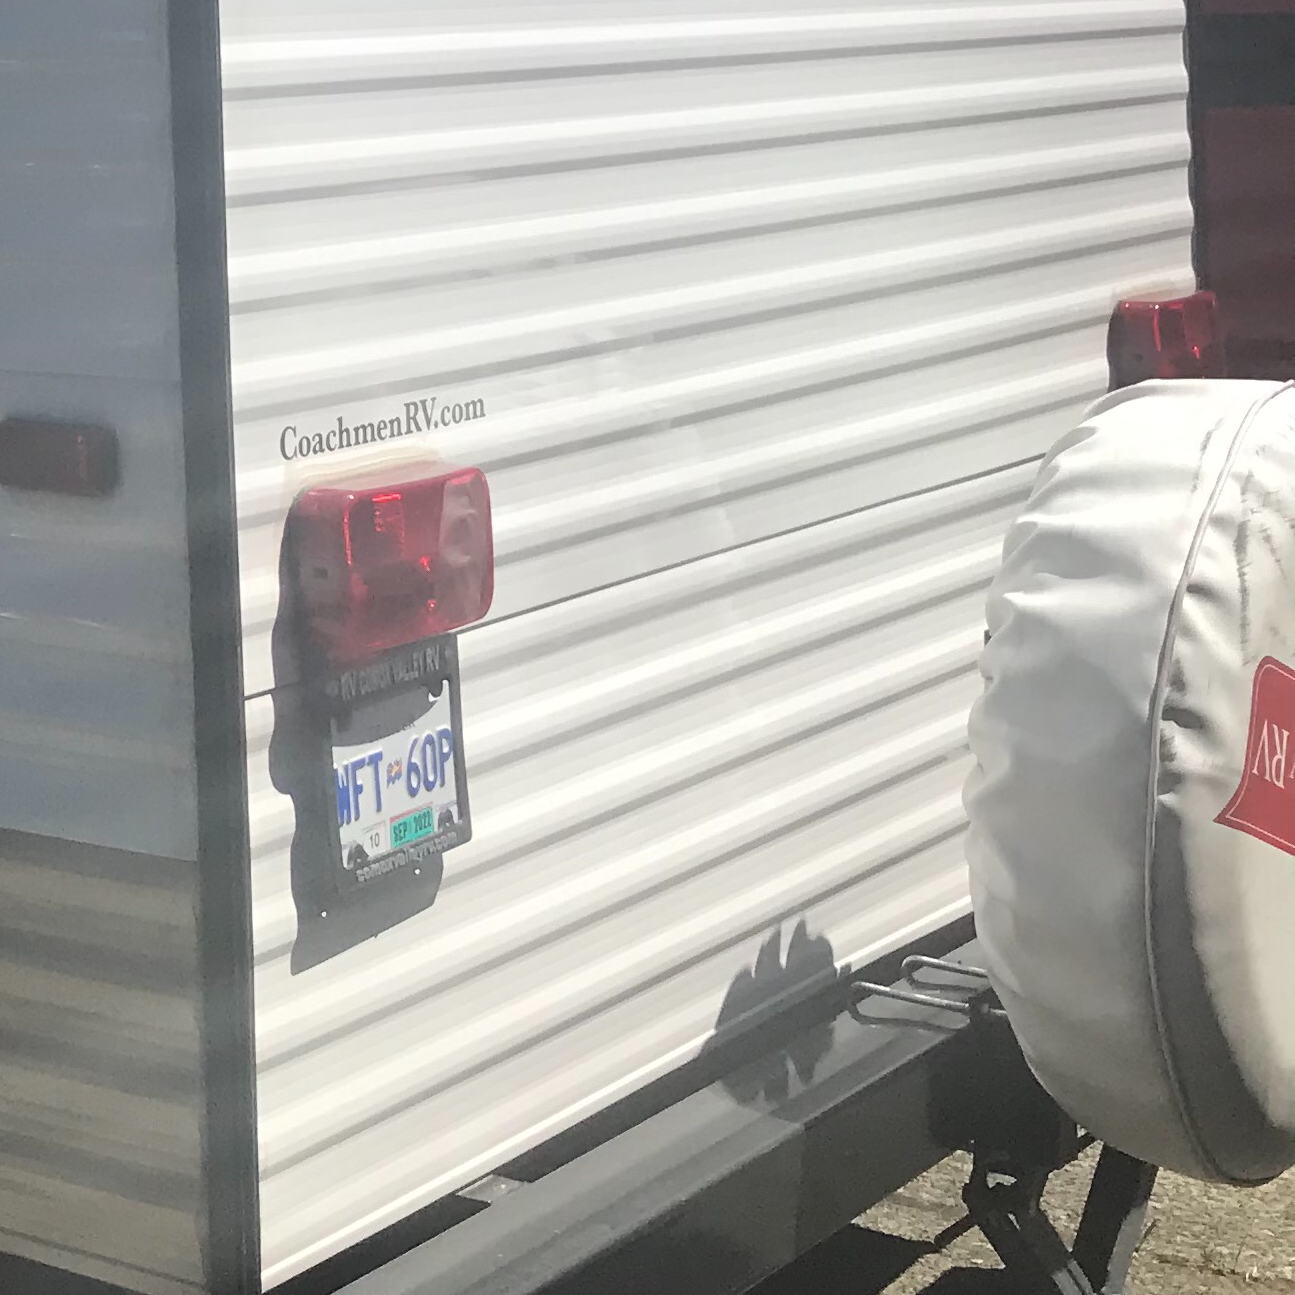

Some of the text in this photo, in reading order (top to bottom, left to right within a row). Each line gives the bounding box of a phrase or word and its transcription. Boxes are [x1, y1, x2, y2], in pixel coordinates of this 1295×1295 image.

[279, 397, 486, 461] CoachmenRV.com
[334, 727, 454, 827] WFT 60P
[1252, 718, 1290, 789] RV
[369, 832, 380, 849] 10
[393, 821, 407, 843] SEP
